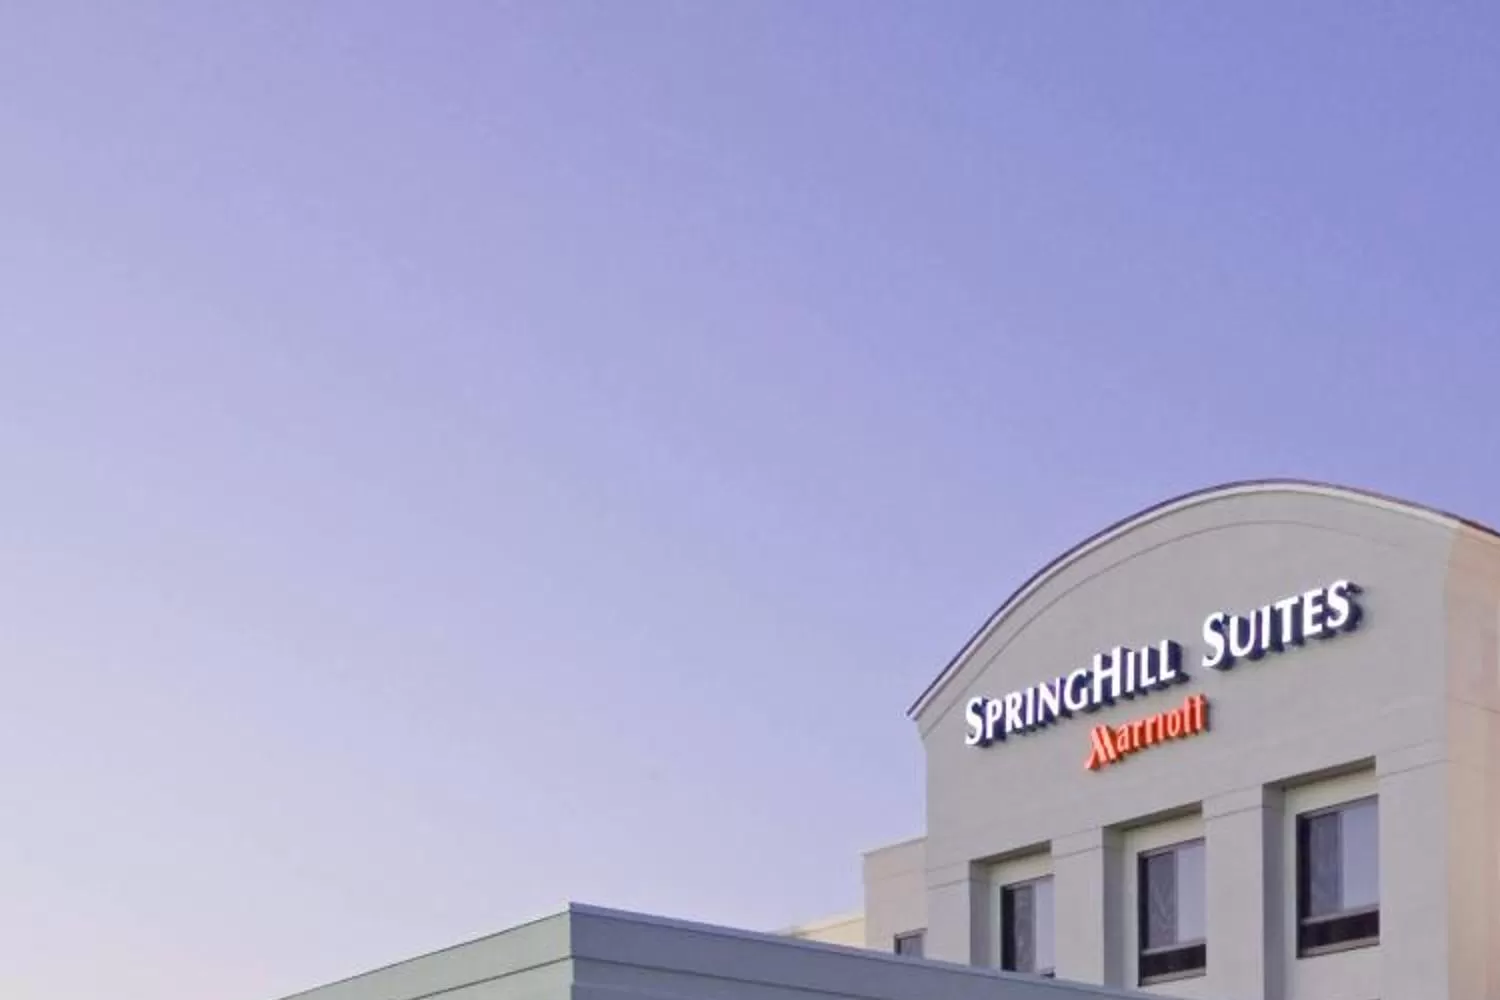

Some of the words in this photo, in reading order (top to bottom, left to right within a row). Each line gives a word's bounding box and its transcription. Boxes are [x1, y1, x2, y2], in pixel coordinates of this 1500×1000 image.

[965, 639, 1187, 747] SPRINGHILL
[1202, 580, 1359, 669] SUITES
[1085, 693, 1209, 770] Marriott
